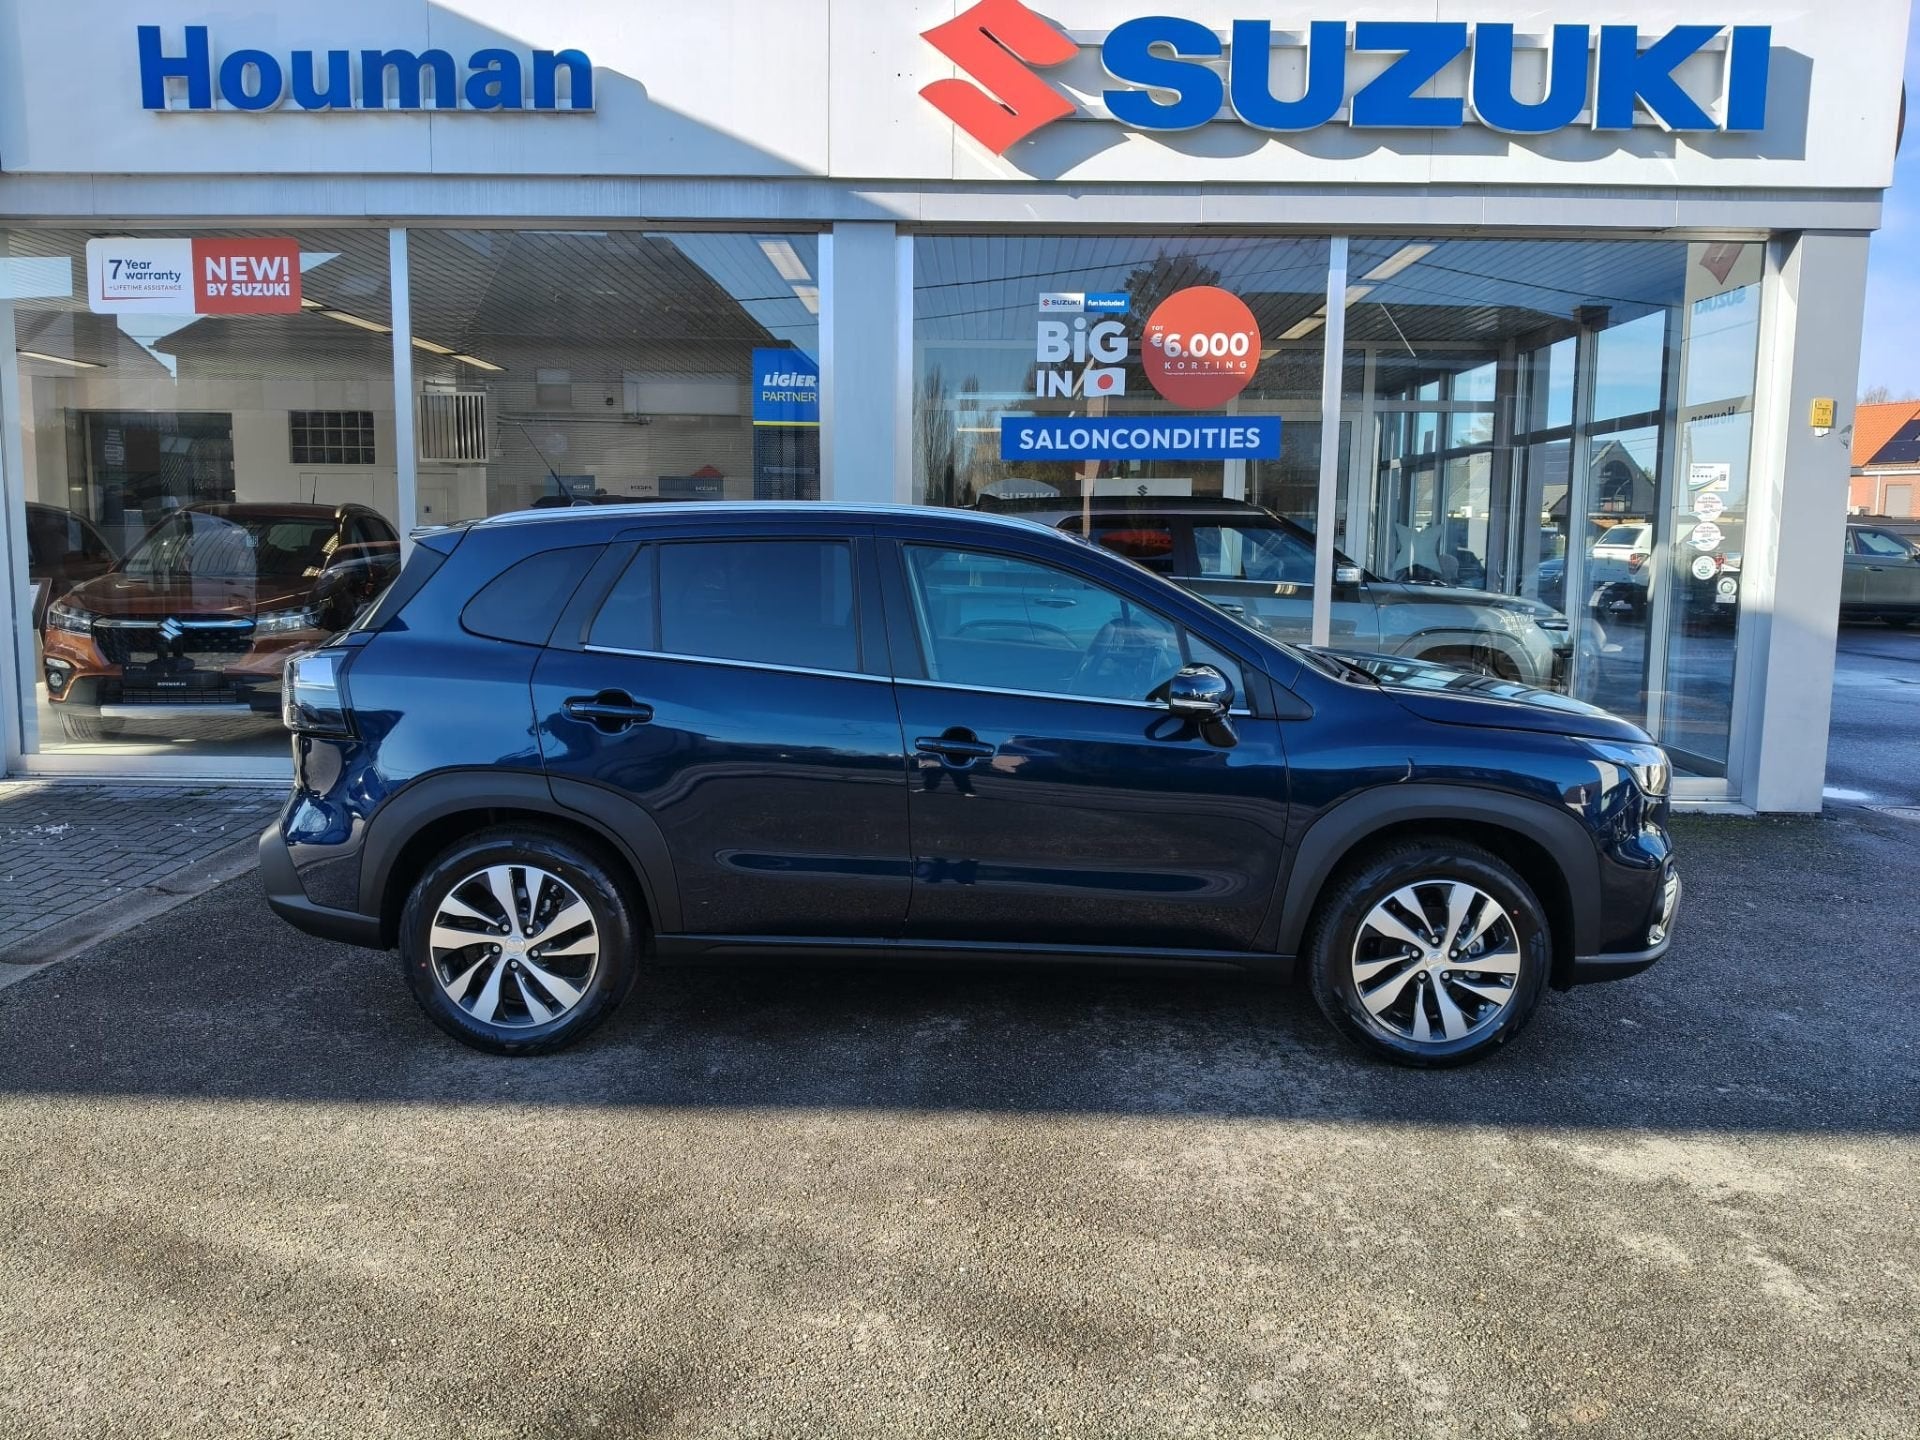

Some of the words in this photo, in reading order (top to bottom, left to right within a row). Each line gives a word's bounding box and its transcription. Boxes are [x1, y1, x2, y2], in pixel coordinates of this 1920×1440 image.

[137, 25, 595, 112] Houman
[1101, 16, 1773, 133] SUZUKI
[109, 259, 123, 280] 7
[125, 259, 152, 270] Year
[125, 270, 182, 283] warranty
[205, 256, 290, 282] NEW!
[207, 283, 227, 296] BY
[1164, 361, 1248, 370] KORTING
[1036, 370, 1073, 397] IN
[762, 391, 817, 402] PARTNER
[1019, 427, 1261, 450] SALONCONDITIES
